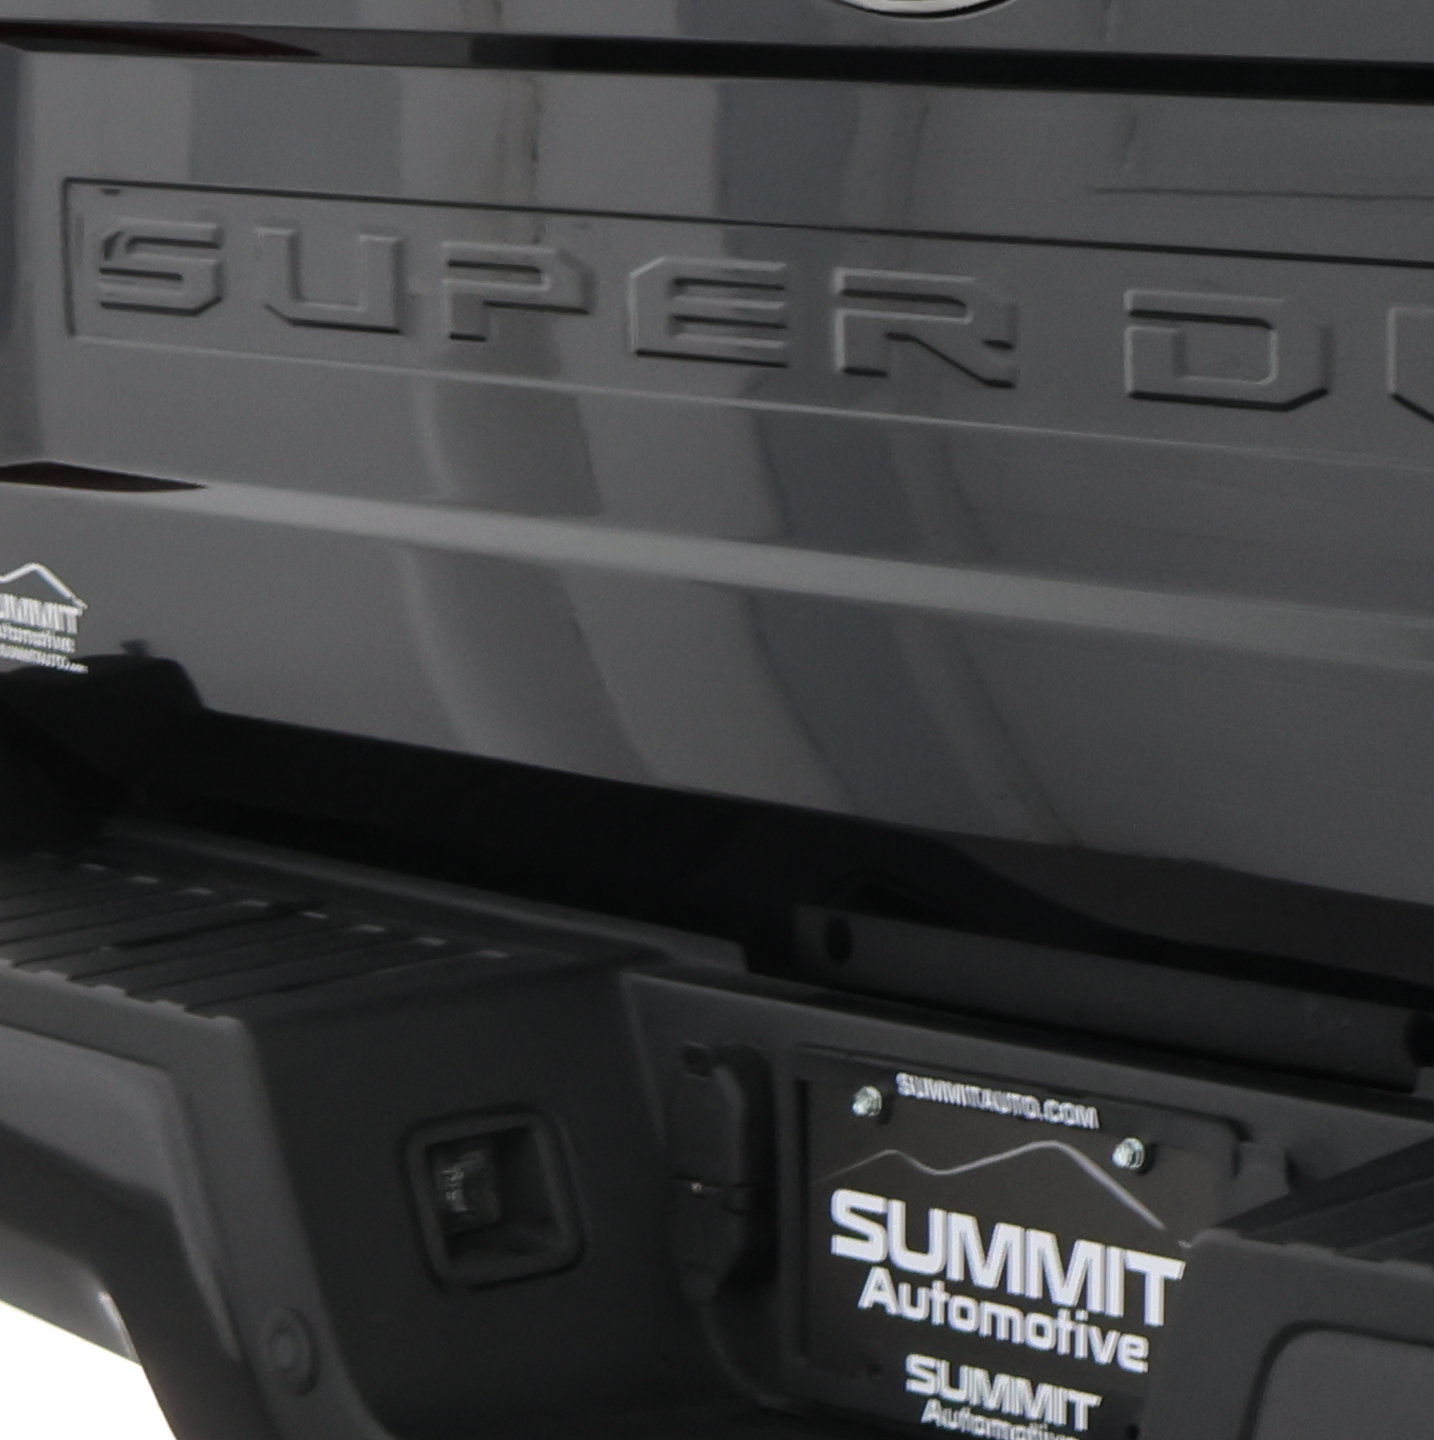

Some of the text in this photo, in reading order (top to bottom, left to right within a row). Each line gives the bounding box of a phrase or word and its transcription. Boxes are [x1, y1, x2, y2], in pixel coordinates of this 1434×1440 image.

[98, 215, 1016, 390] SUPER
[895, 1072, 1100, 1130] SUMMITAUTO.COM
[830, 1188, 1187, 1327] SUMMIT
[857, 1266, 1150, 1374] Automotive
[905, 1354, 1103, 1431] SUMMIT
